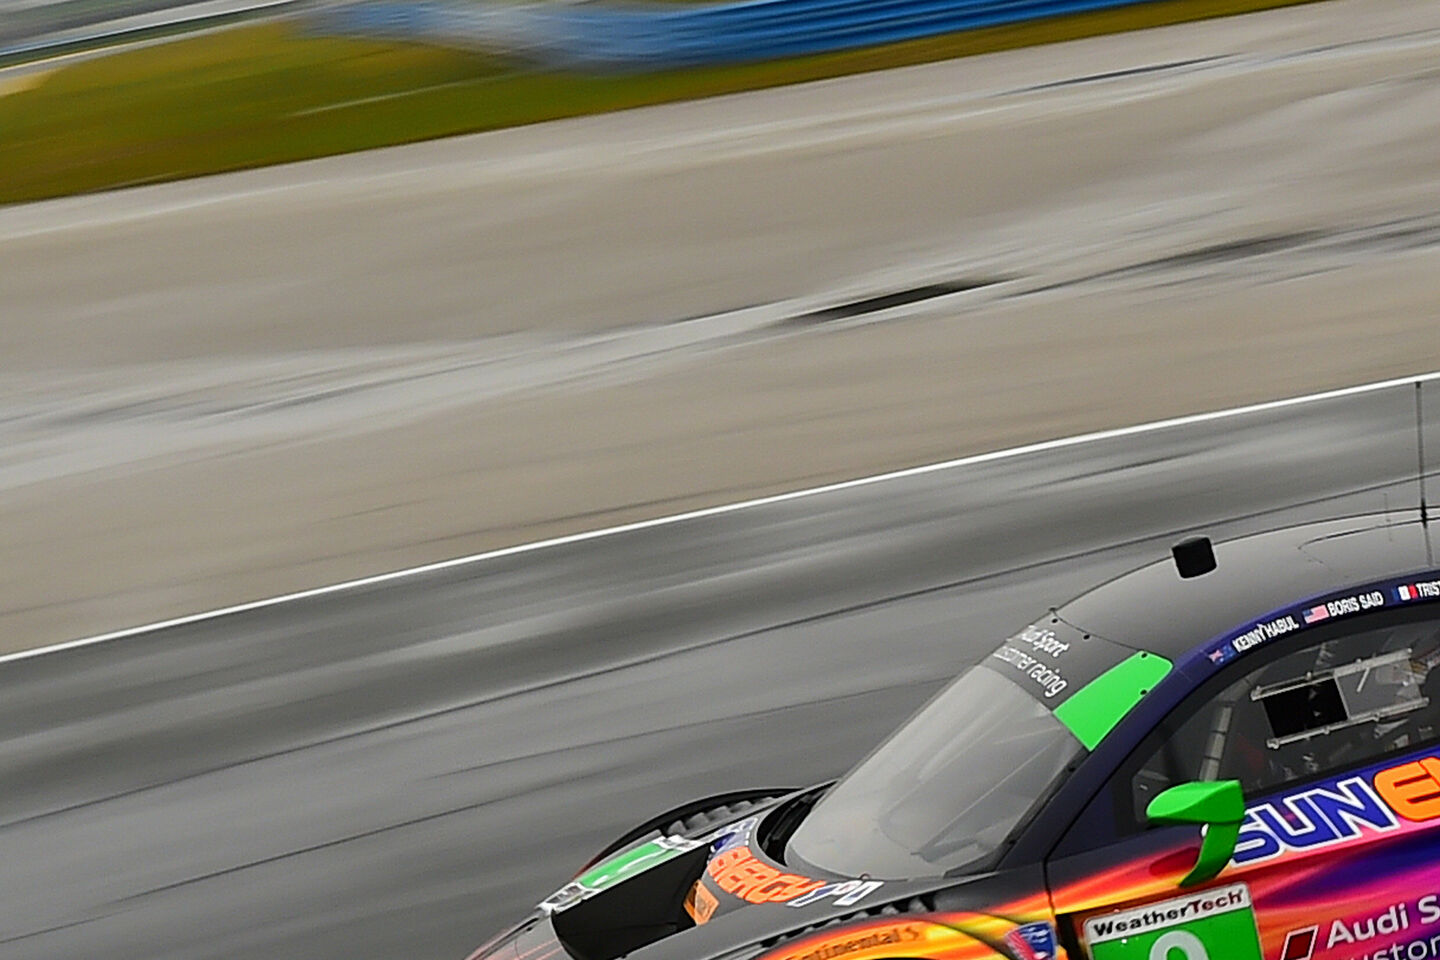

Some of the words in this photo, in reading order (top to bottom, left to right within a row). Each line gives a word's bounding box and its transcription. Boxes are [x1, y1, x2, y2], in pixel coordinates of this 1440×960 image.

[1328, 596, 1360, 617] BORIS
[1359, 591, 1384, 609] SAID
[1232, 622, 1268, 653] KENNY
[1267, 615, 1300, 638] HABUL
[1027, 663, 1068, 698] racing
[1093, 889, 1243, 937] WeatherTech
[1326, 902, 1409, 950] Audi
